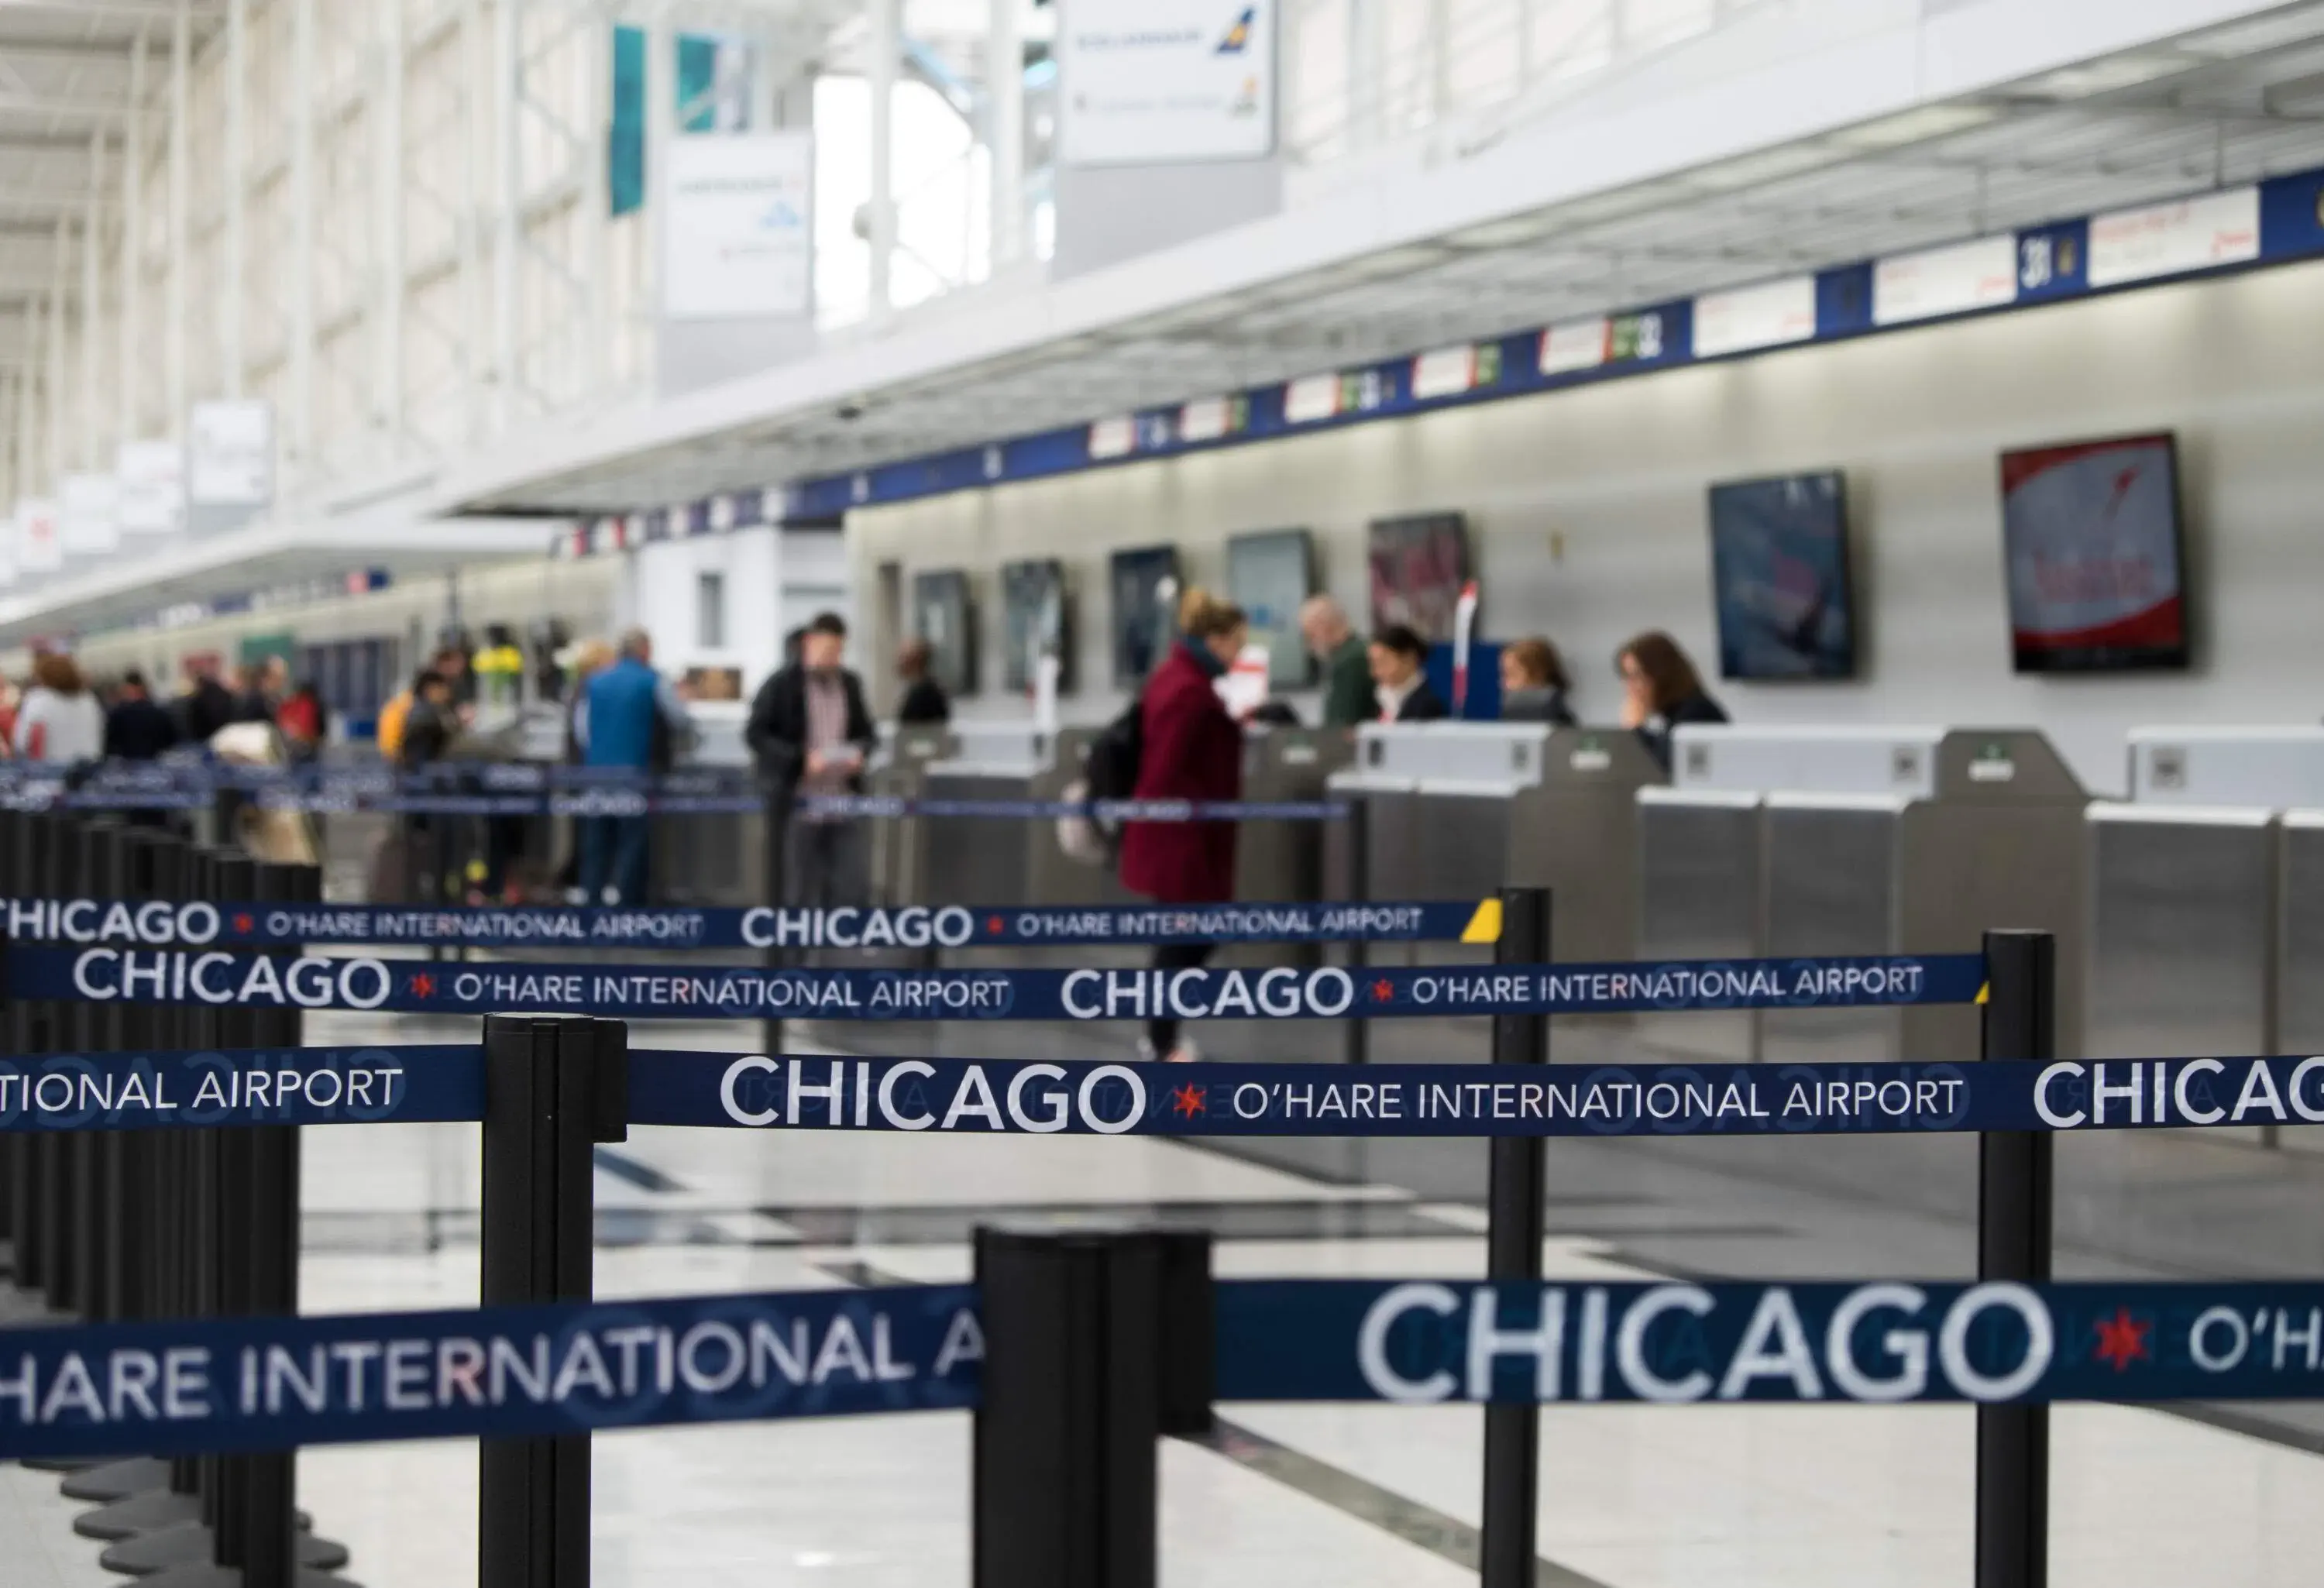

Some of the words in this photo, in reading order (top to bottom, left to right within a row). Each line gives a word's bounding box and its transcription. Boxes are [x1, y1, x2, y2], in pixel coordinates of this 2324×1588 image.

[0, 898, 220, 944] HICAGO
[266, 911, 370, 937] O'HARE
[375, 912, 586, 939] INTERNATIONAL
[592, 914, 703, 938] AIRPORT
[741, 905, 974, 947] CHICAGO
[1016, 913, 1111, 937] O'HARE
[1119, 909, 1312, 936] INTERNATIONAL
[1319, 907, 1424, 932] AIRPORT
[73, 947, 391, 1009] CHICAGO
[454, 973, 583, 1002] O'HARE
[594, 975, 861, 1007] INTERNATIONAL
[870, 979, 1009, 1007] AIRPORT
[1061, 967, 1354, 1018] CHICAGO
[1412, 976, 1531, 1004] O'HARE
[1540, 968, 1786, 1001] INTERNATIONAL
[1794, 966, 1924, 996] AIRPORT
[0, 1072, 177, 1112] TIONAL
[191, 1069, 403, 1109] AIRPORT
[720, 1055, 1147, 1134] CHICAGO
[1233, 1082, 1401, 1119] O'HARE
[1419, 1082, 1770, 1119] INTERNATIONAL
[1783, 1079, 1964, 1116] AIRPORT
[240, 1312, 916, 1414] INTERNATIONAL
[1356, 1280, 2054, 1404] CHICAGO
[2188, 1305, 2324, 1372] O'H
